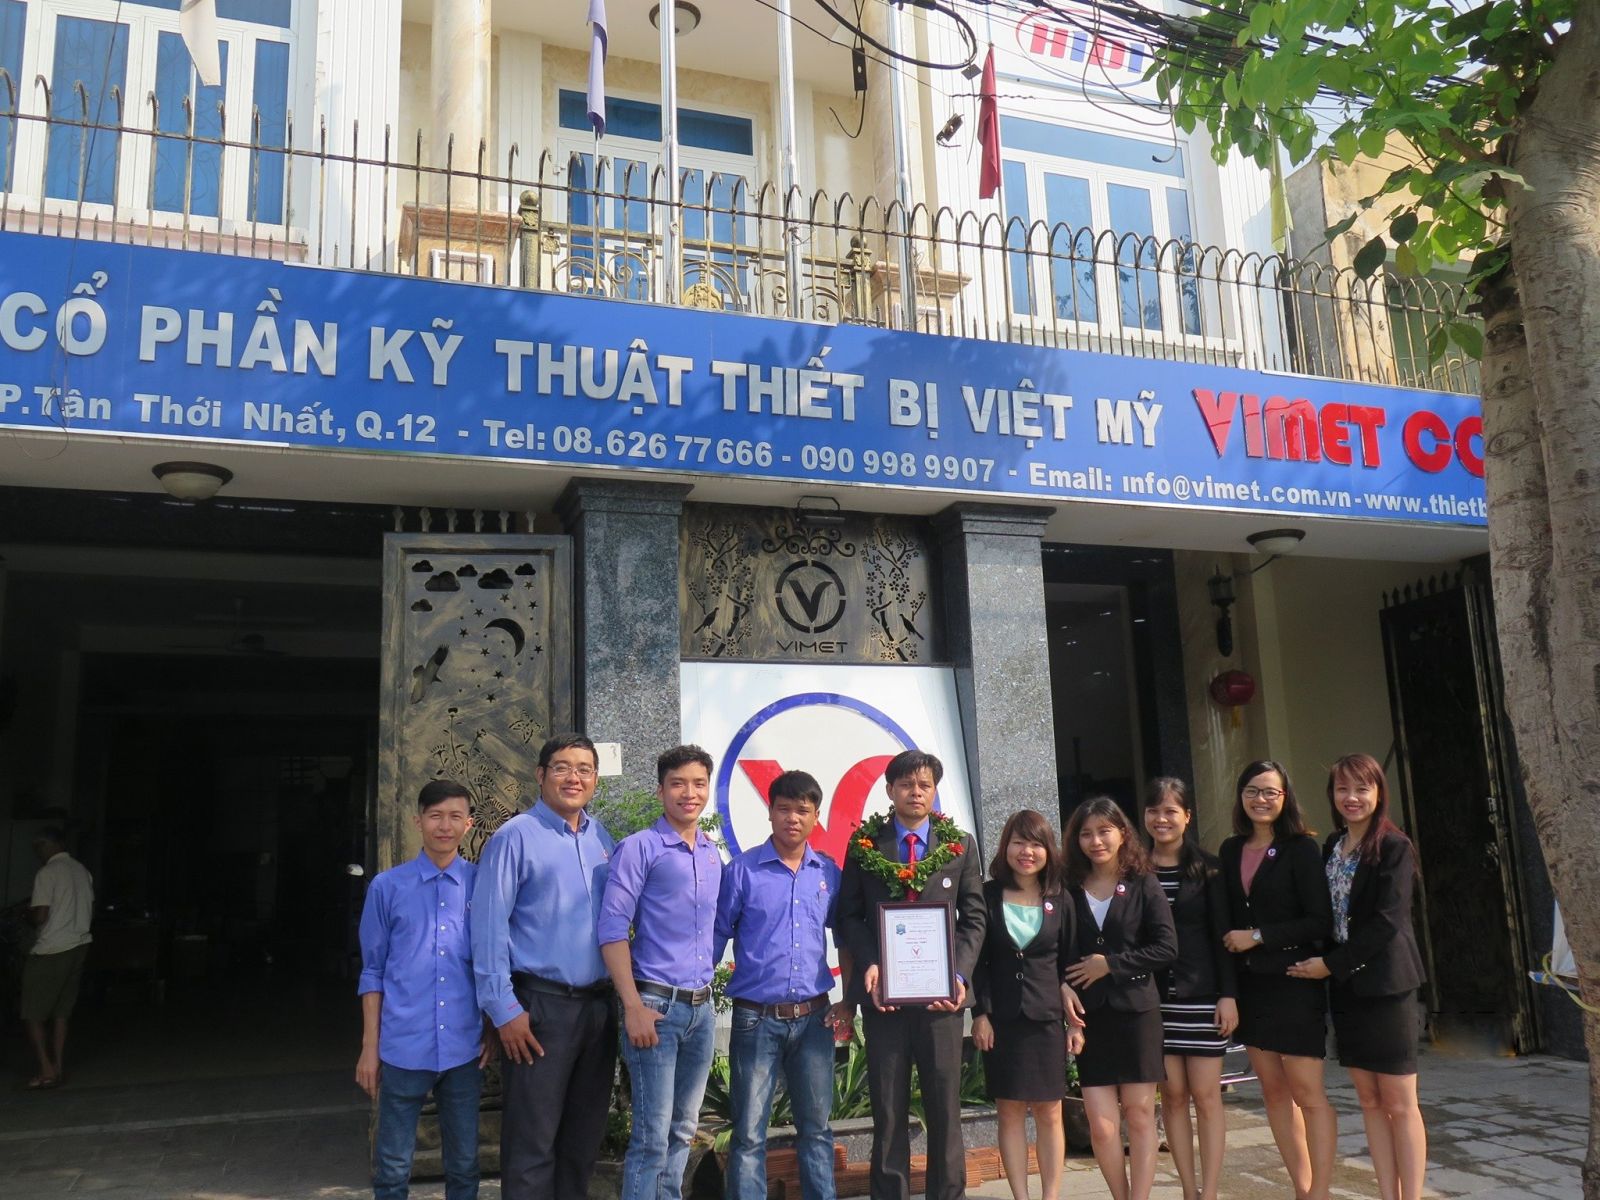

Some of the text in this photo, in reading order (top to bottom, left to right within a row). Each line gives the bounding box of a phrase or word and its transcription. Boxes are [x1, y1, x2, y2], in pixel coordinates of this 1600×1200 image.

[0, 271, 108, 356] CỔ
[139, 287, 338, 376] PHẦN
[369, 317, 464, 386] KỸ
[495, 338, 694, 414] THUẬT
[711, 346, 865, 421] THIẾT
[889, 378, 939, 439] BỊ
[961, 378, 1073, 449] VIỆT
[1096, 391, 1163, 448] MỸ
[1193, 388, 1386, 468] VIMET
[134, 393, 222, 428] Thới
[801, 444, 854, 473] 090
[863, 450, 916, 477] 998
[925, 454, 995, 482] 9907
[1029, 462, 1112, 491] Email:
[776, 639, 849, 654] VIMET
